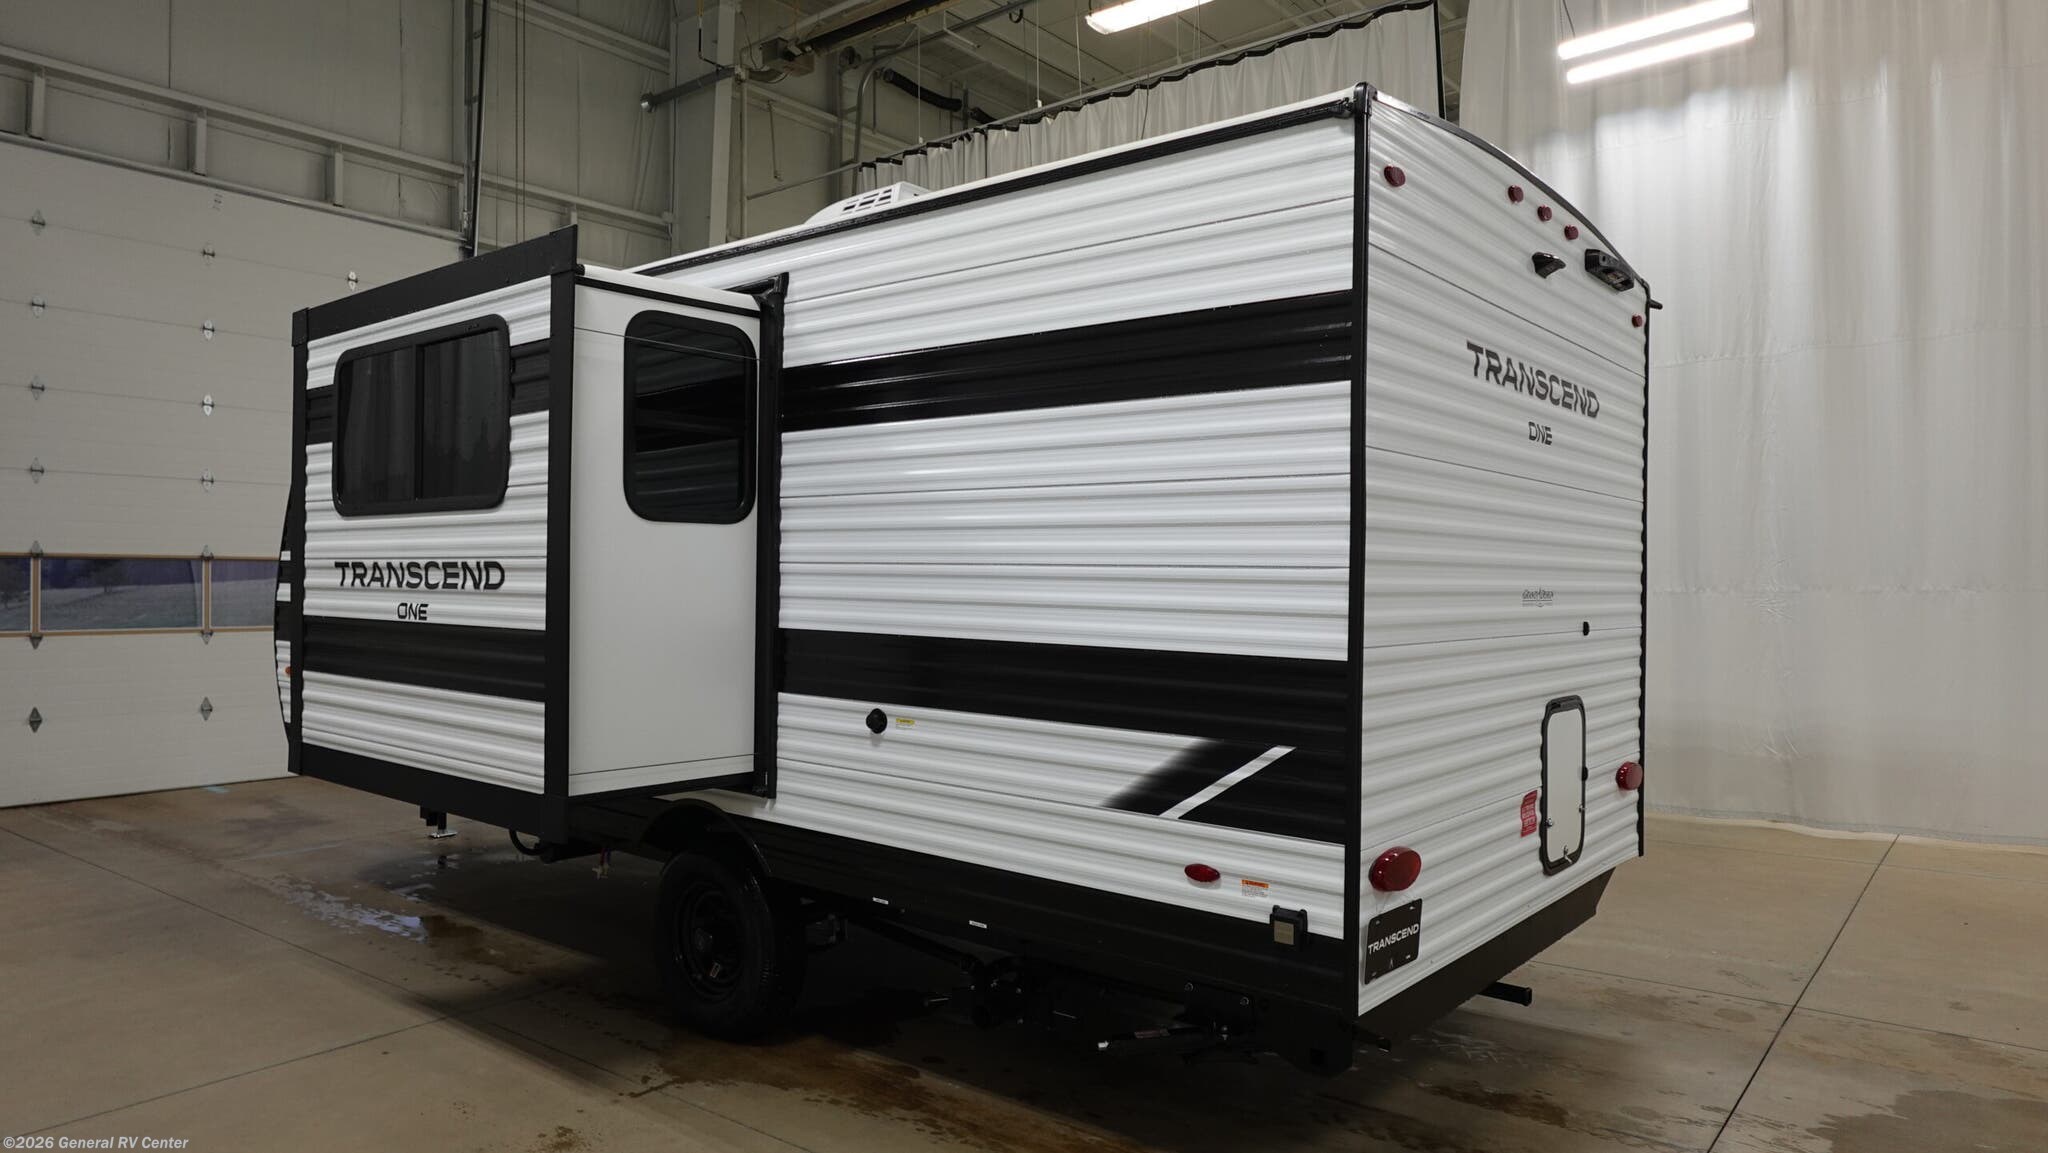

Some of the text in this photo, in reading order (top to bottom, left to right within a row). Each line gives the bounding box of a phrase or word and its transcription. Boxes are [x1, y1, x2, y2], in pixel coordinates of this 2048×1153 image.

[1467, 340, 1600, 419] TRANSCEND
[1528, 421, 1553, 446] ONE
[334, 560, 506, 591] TRANSCEND
[397, 602, 429, 621] ONE
[1367, 923, 1420, 956] TRANSCEND
